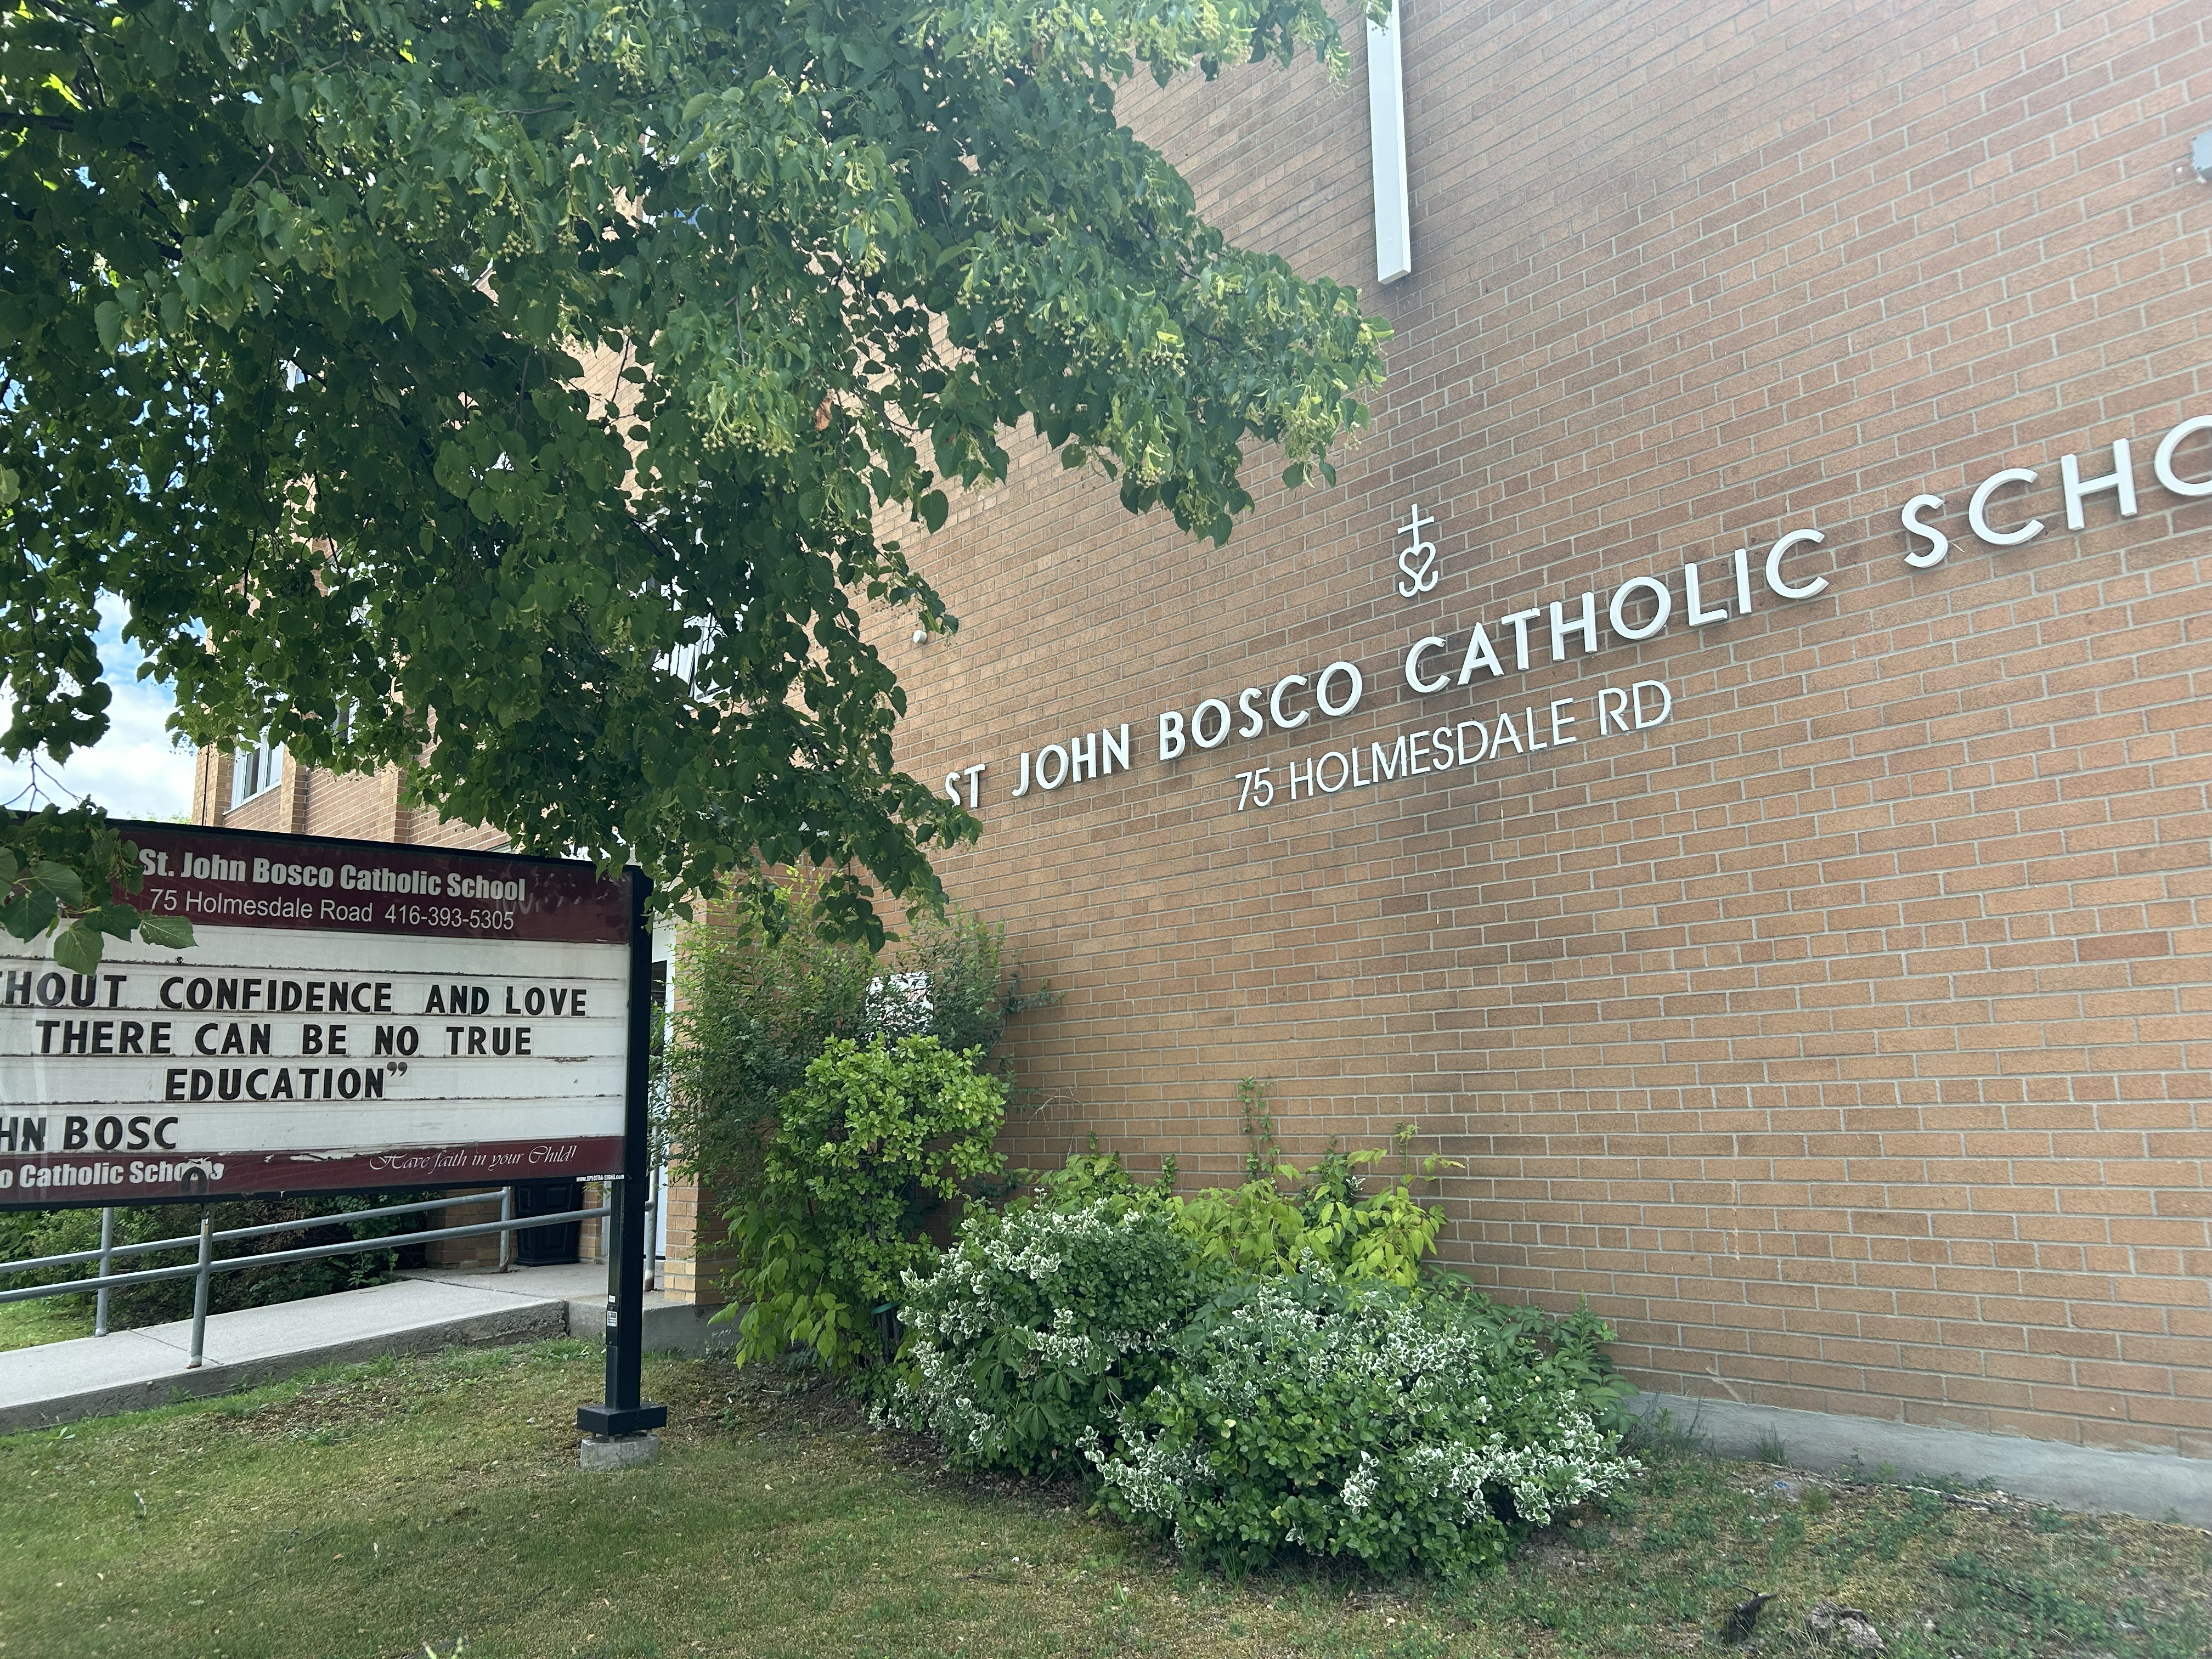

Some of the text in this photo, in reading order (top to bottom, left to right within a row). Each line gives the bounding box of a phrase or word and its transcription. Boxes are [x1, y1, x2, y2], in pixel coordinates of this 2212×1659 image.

[945, 763, 985, 809] ST
[1012, 724, 1130, 798] JOHN
[1160, 661, 1363, 761] BOSCO
[1405, 529, 1830, 693] CATHOLIC
[1235, 680, 1672, 811] 75 HOLMESDALE RD
[139, 848, 526, 901] St. John Bosco Catholic School
[150, 888, 515, 930] 75 Holmesdale Road 416-393-5305
[0, 970, 587, 1017] HOUT CONFIDENCE AND LOVE
[36, 1020, 532, 1056] THERE CAN BE NO TRUE
[63, 1116, 178, 1150] BOSC
[19, 1161, 123, 1189] Catholic
[129, 1159, 225, 1184] Schos
[369, 1145, 577, 1174] Have faith in your Child!
